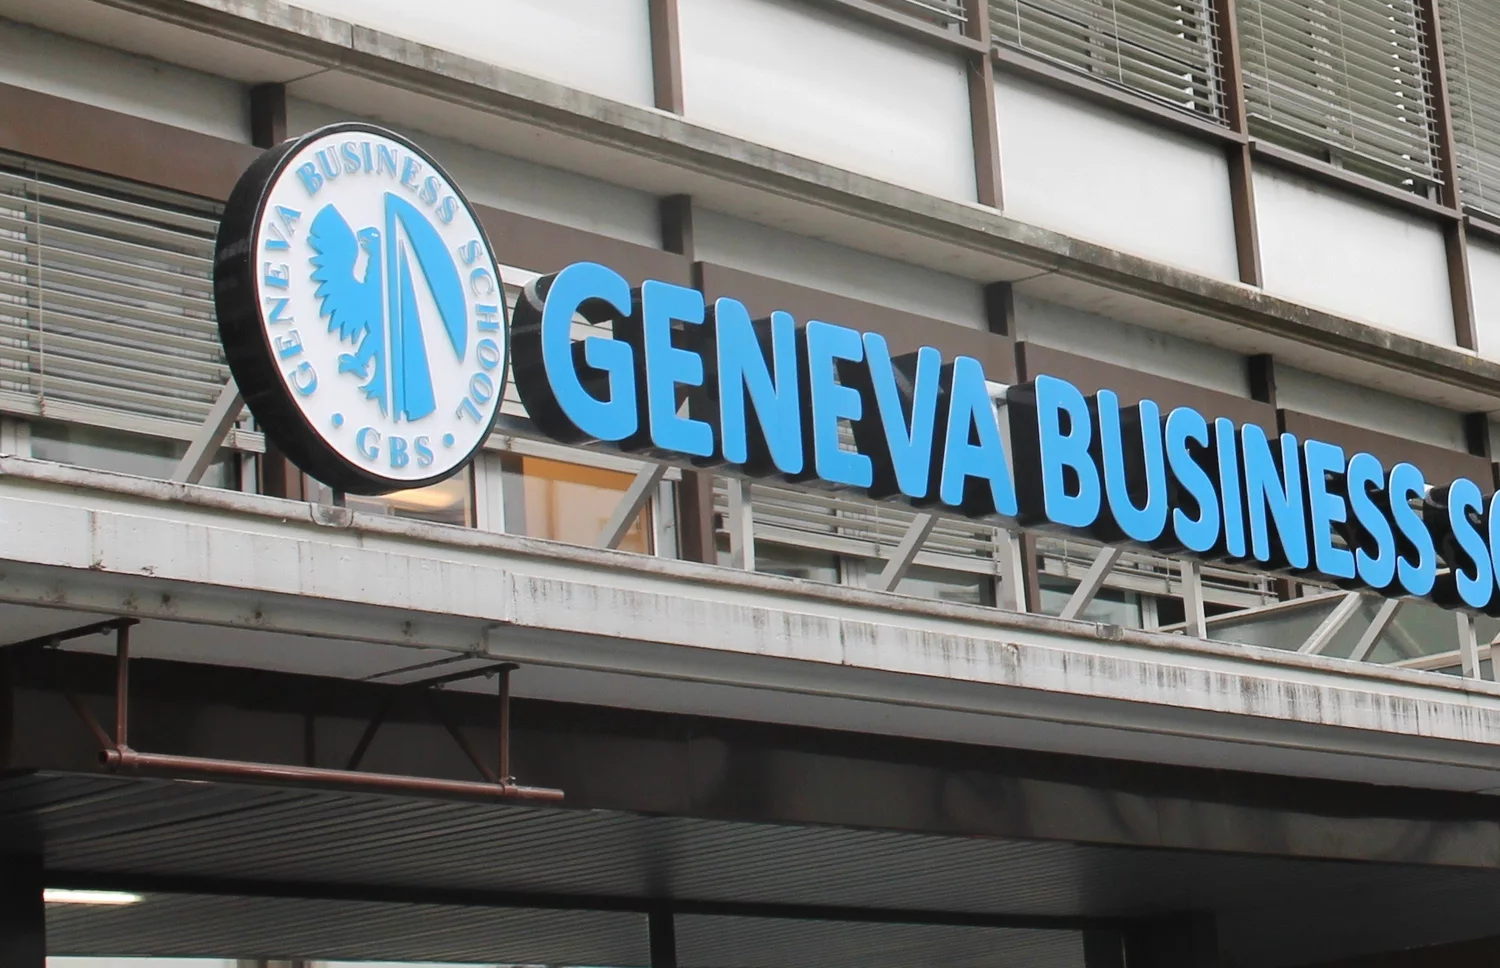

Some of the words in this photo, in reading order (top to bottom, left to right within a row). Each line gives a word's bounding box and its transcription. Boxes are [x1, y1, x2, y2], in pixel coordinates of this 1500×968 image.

[264, 205, 318, 397] GENEVA
[295, 141, 460, 225] BUSINESS
[455, 238, 502, 423] SCHOOL
[355, 426, 435, 469] GBS
[541, 261, 1019, 517] GENEVA
[1035, 374, 1437, 597] BUSINESS
